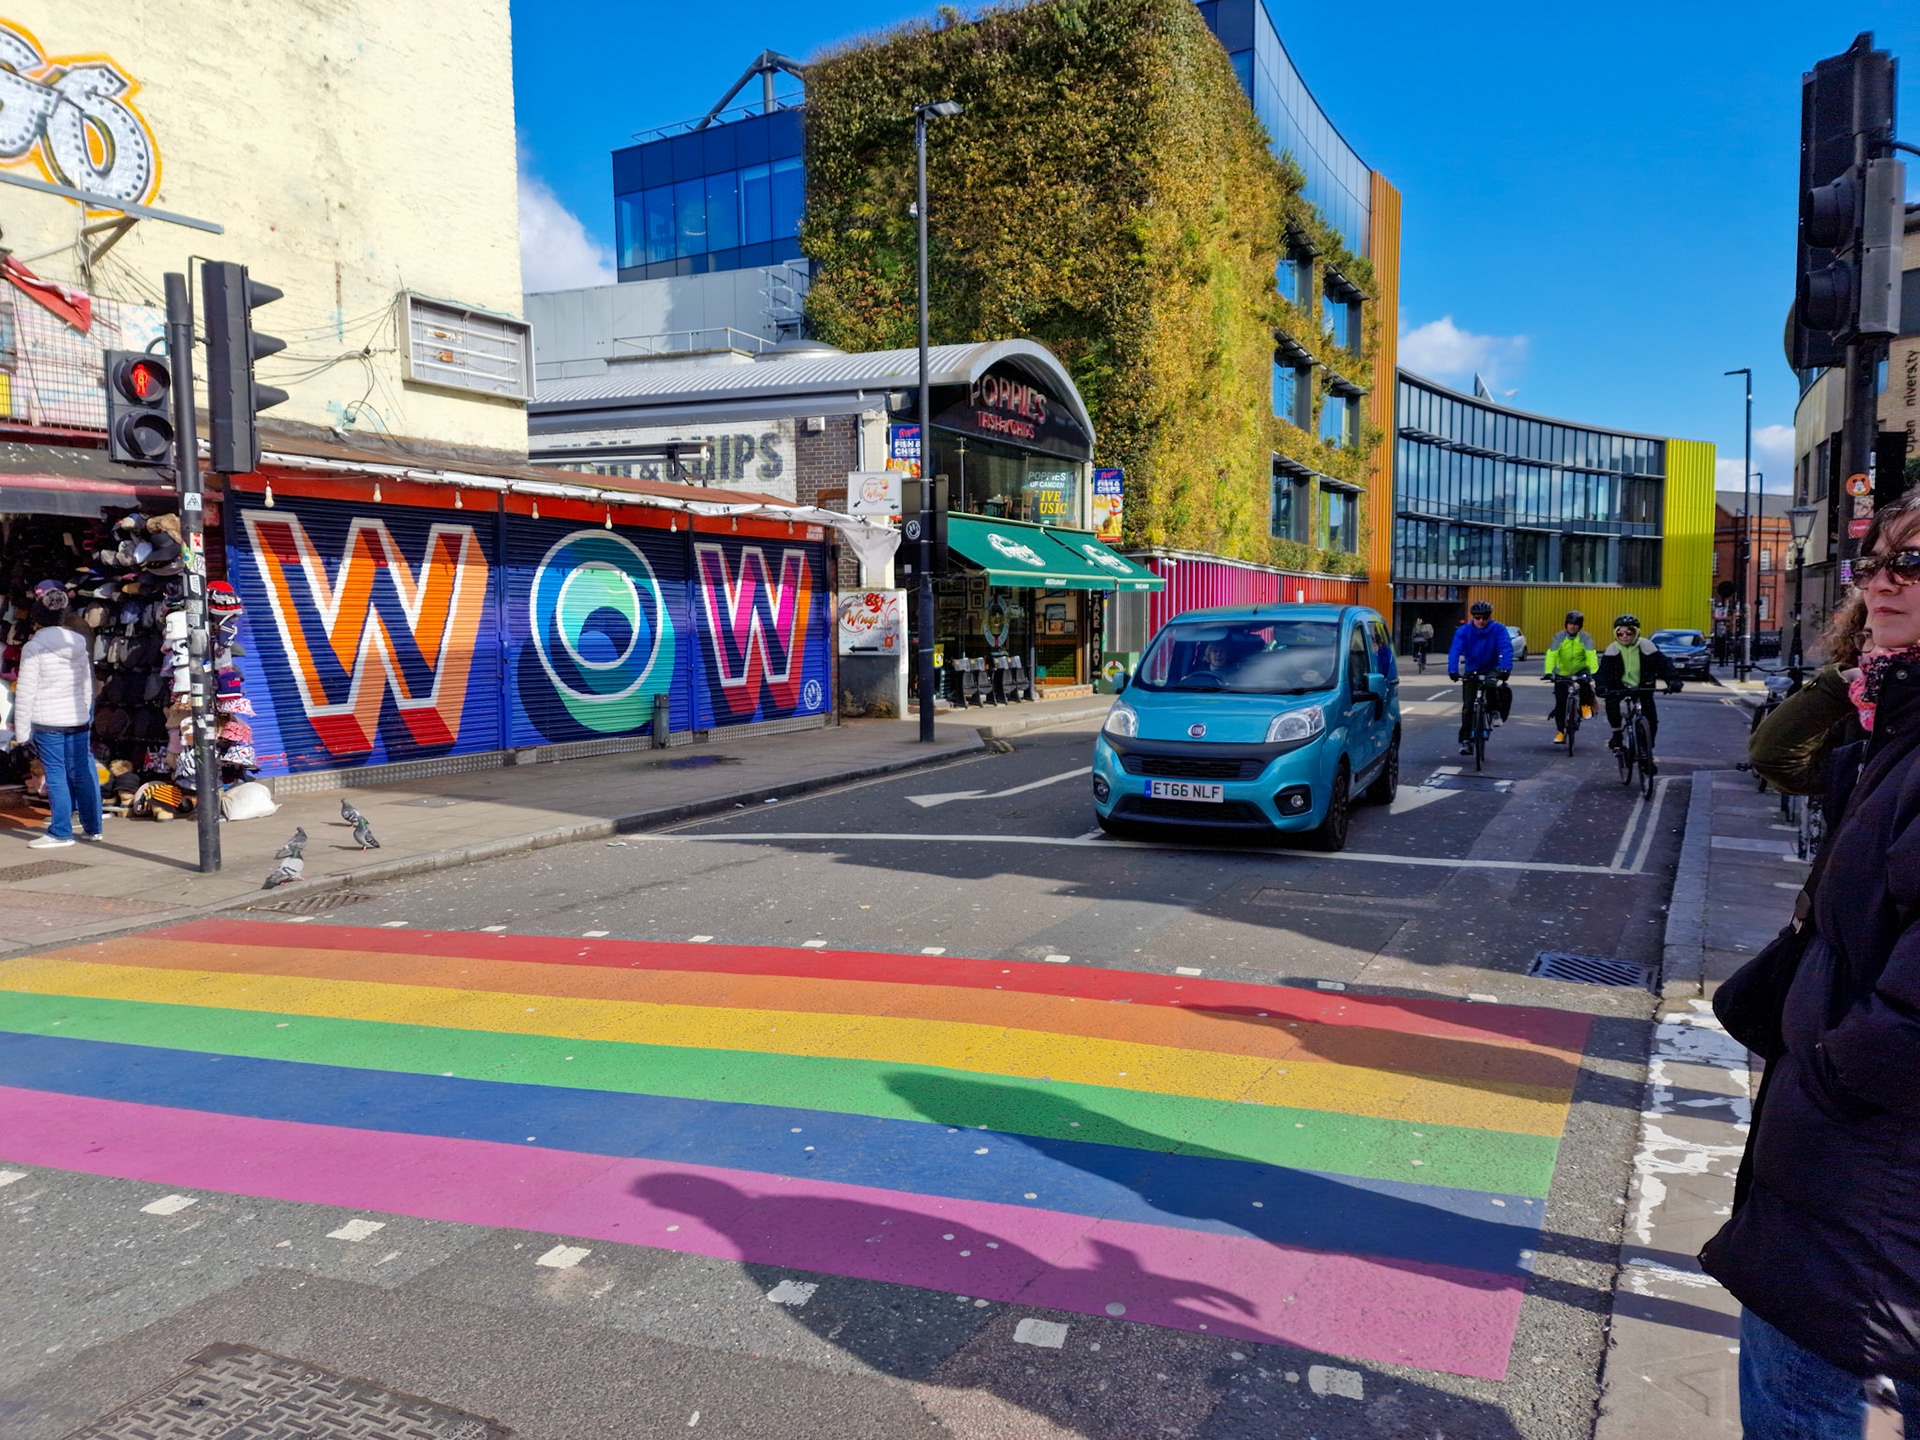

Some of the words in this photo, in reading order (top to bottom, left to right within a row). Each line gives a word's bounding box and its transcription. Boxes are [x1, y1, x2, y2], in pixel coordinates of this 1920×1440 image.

[969, 374, 1047, 424] POPPIES
[978, 411, 1001, 430] FISH
[1008, 420, 1035, 438] CHIPS
[894, 440, 914, 448] FISH
[894, 447, 920, 456] CHIPS
[1028, 471, 1067, 481] POPPIES
[1097, 479, 1113, 487] FISH
[1040, 490, 1061, 502] IVE
[1040, 502, 1067, 514] USIC
[1092, 594, 1101, 629] TAKE
[842, 609, 879, 630] Wings
[1092, 632, 1101, 666] AWAY
[1153, 782, 1189, 797] ET66
[1192, 785, 1220, 799] NLF
